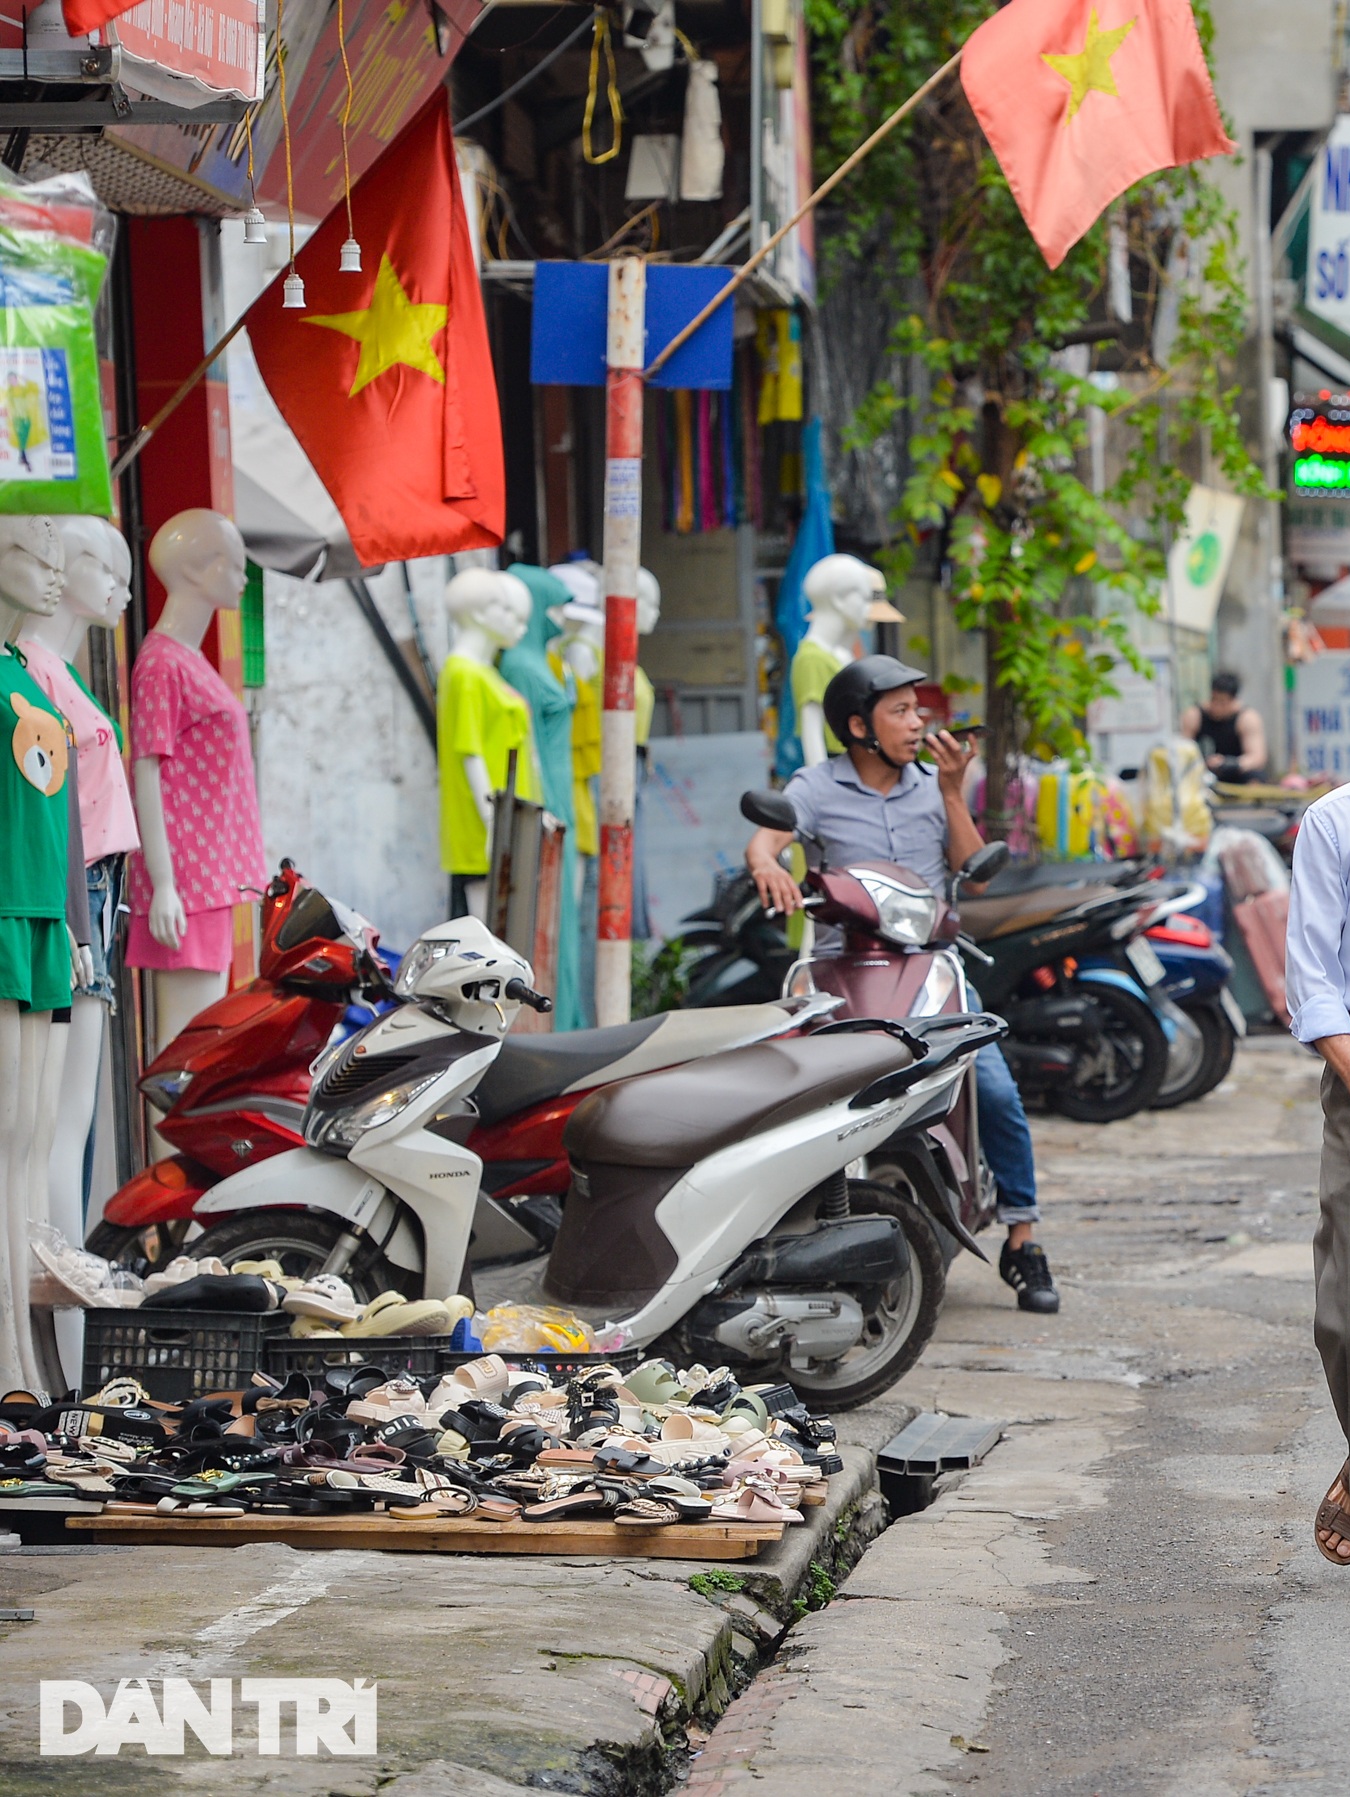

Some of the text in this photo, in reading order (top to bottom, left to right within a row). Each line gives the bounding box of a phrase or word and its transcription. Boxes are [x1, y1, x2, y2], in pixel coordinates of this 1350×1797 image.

[429, 1169, 471, 1180] HONDA
[69, 1412, 79, 1436] NEW
[373, 1415, 424, 1443] Hello
